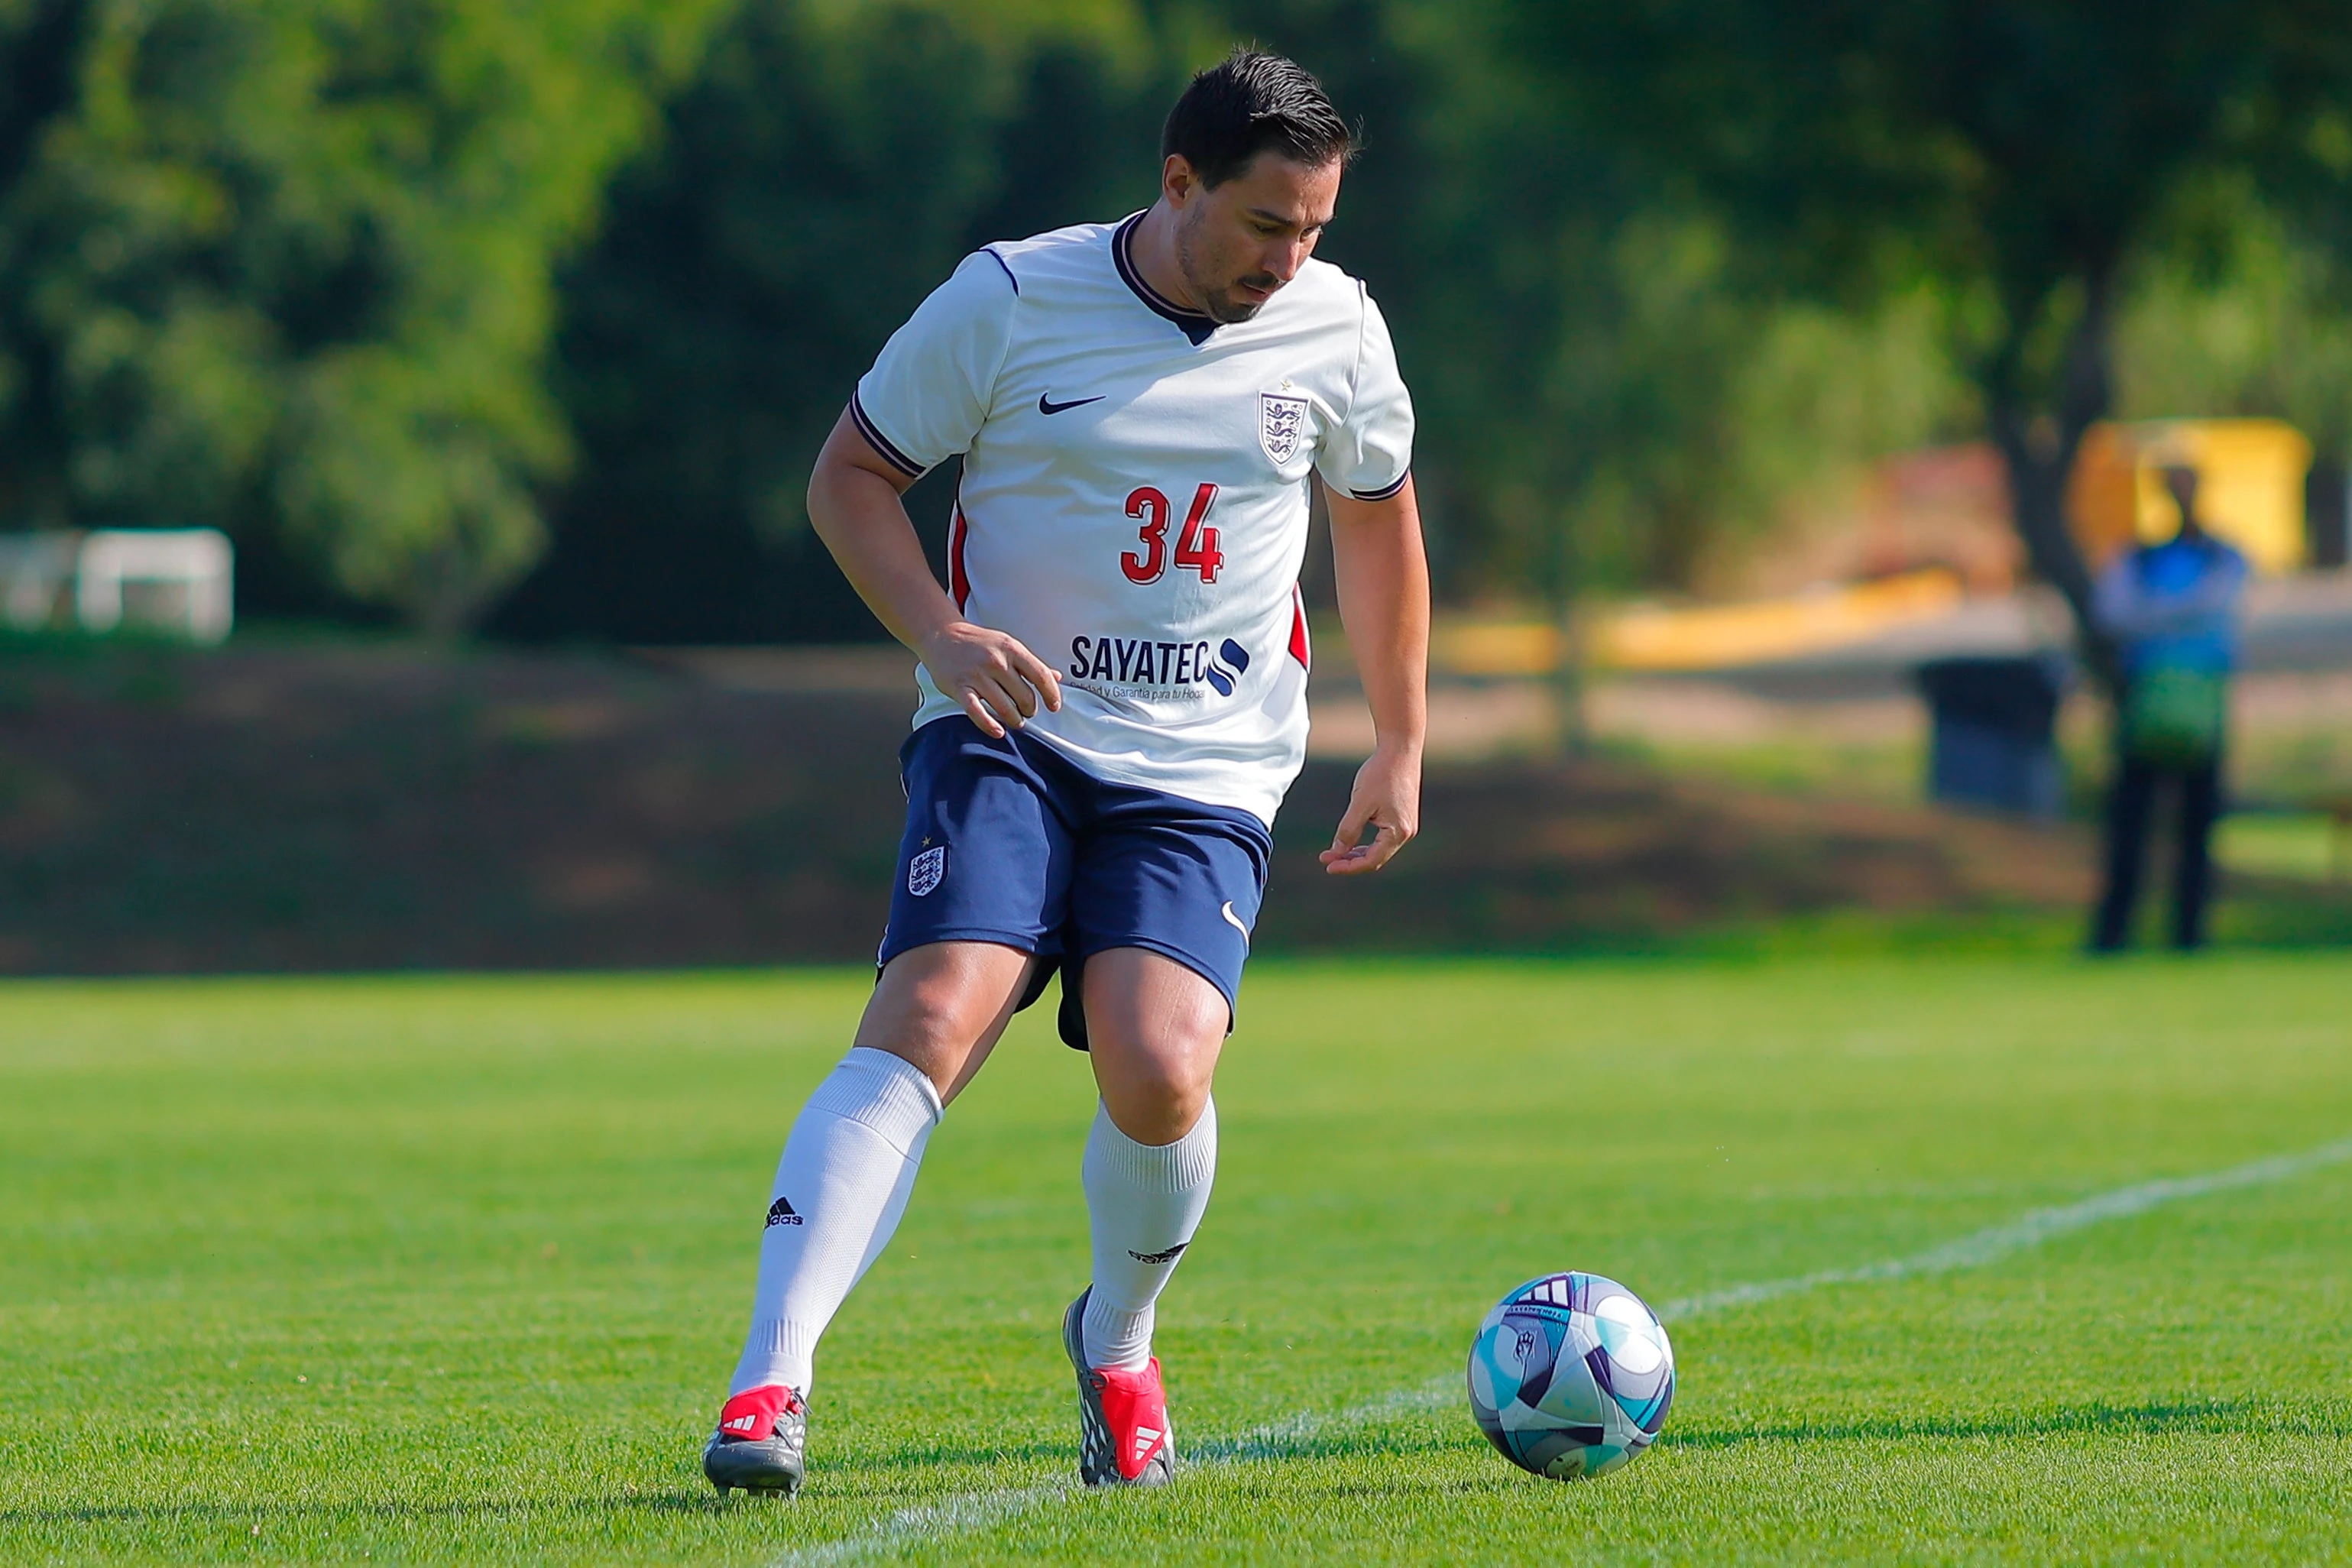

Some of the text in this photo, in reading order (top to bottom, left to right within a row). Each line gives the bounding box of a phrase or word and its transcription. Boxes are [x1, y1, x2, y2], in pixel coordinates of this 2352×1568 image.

[1120, 482, 1225, 585] 34
[1070, 635, 1209, 685] SAYATEC
[1104, 688, 1111, 698] y
[1113, 685, 1149, 699] Garantía
[1152, 690, 1171, 701] para
[1172, 688, 1181, 699] tu
